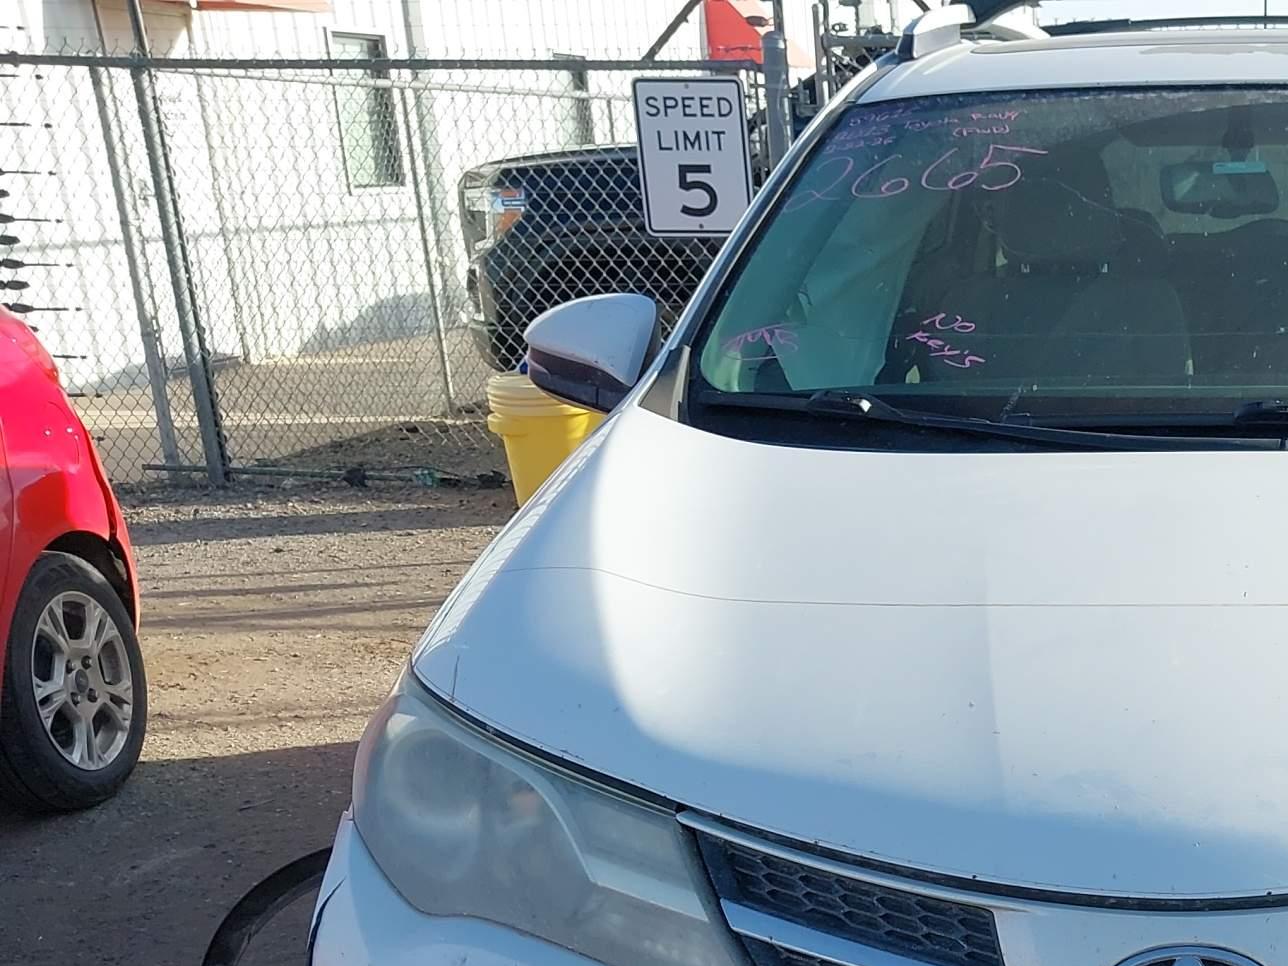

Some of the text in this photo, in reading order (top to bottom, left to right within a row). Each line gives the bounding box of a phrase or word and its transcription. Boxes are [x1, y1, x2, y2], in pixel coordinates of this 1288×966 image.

[645, 96, 733, 118] SPEED
[657, 130, 726, 152] LIMIT
[677, 163, 719, 218] 5
[784, 144, 1049, 213] 2665
